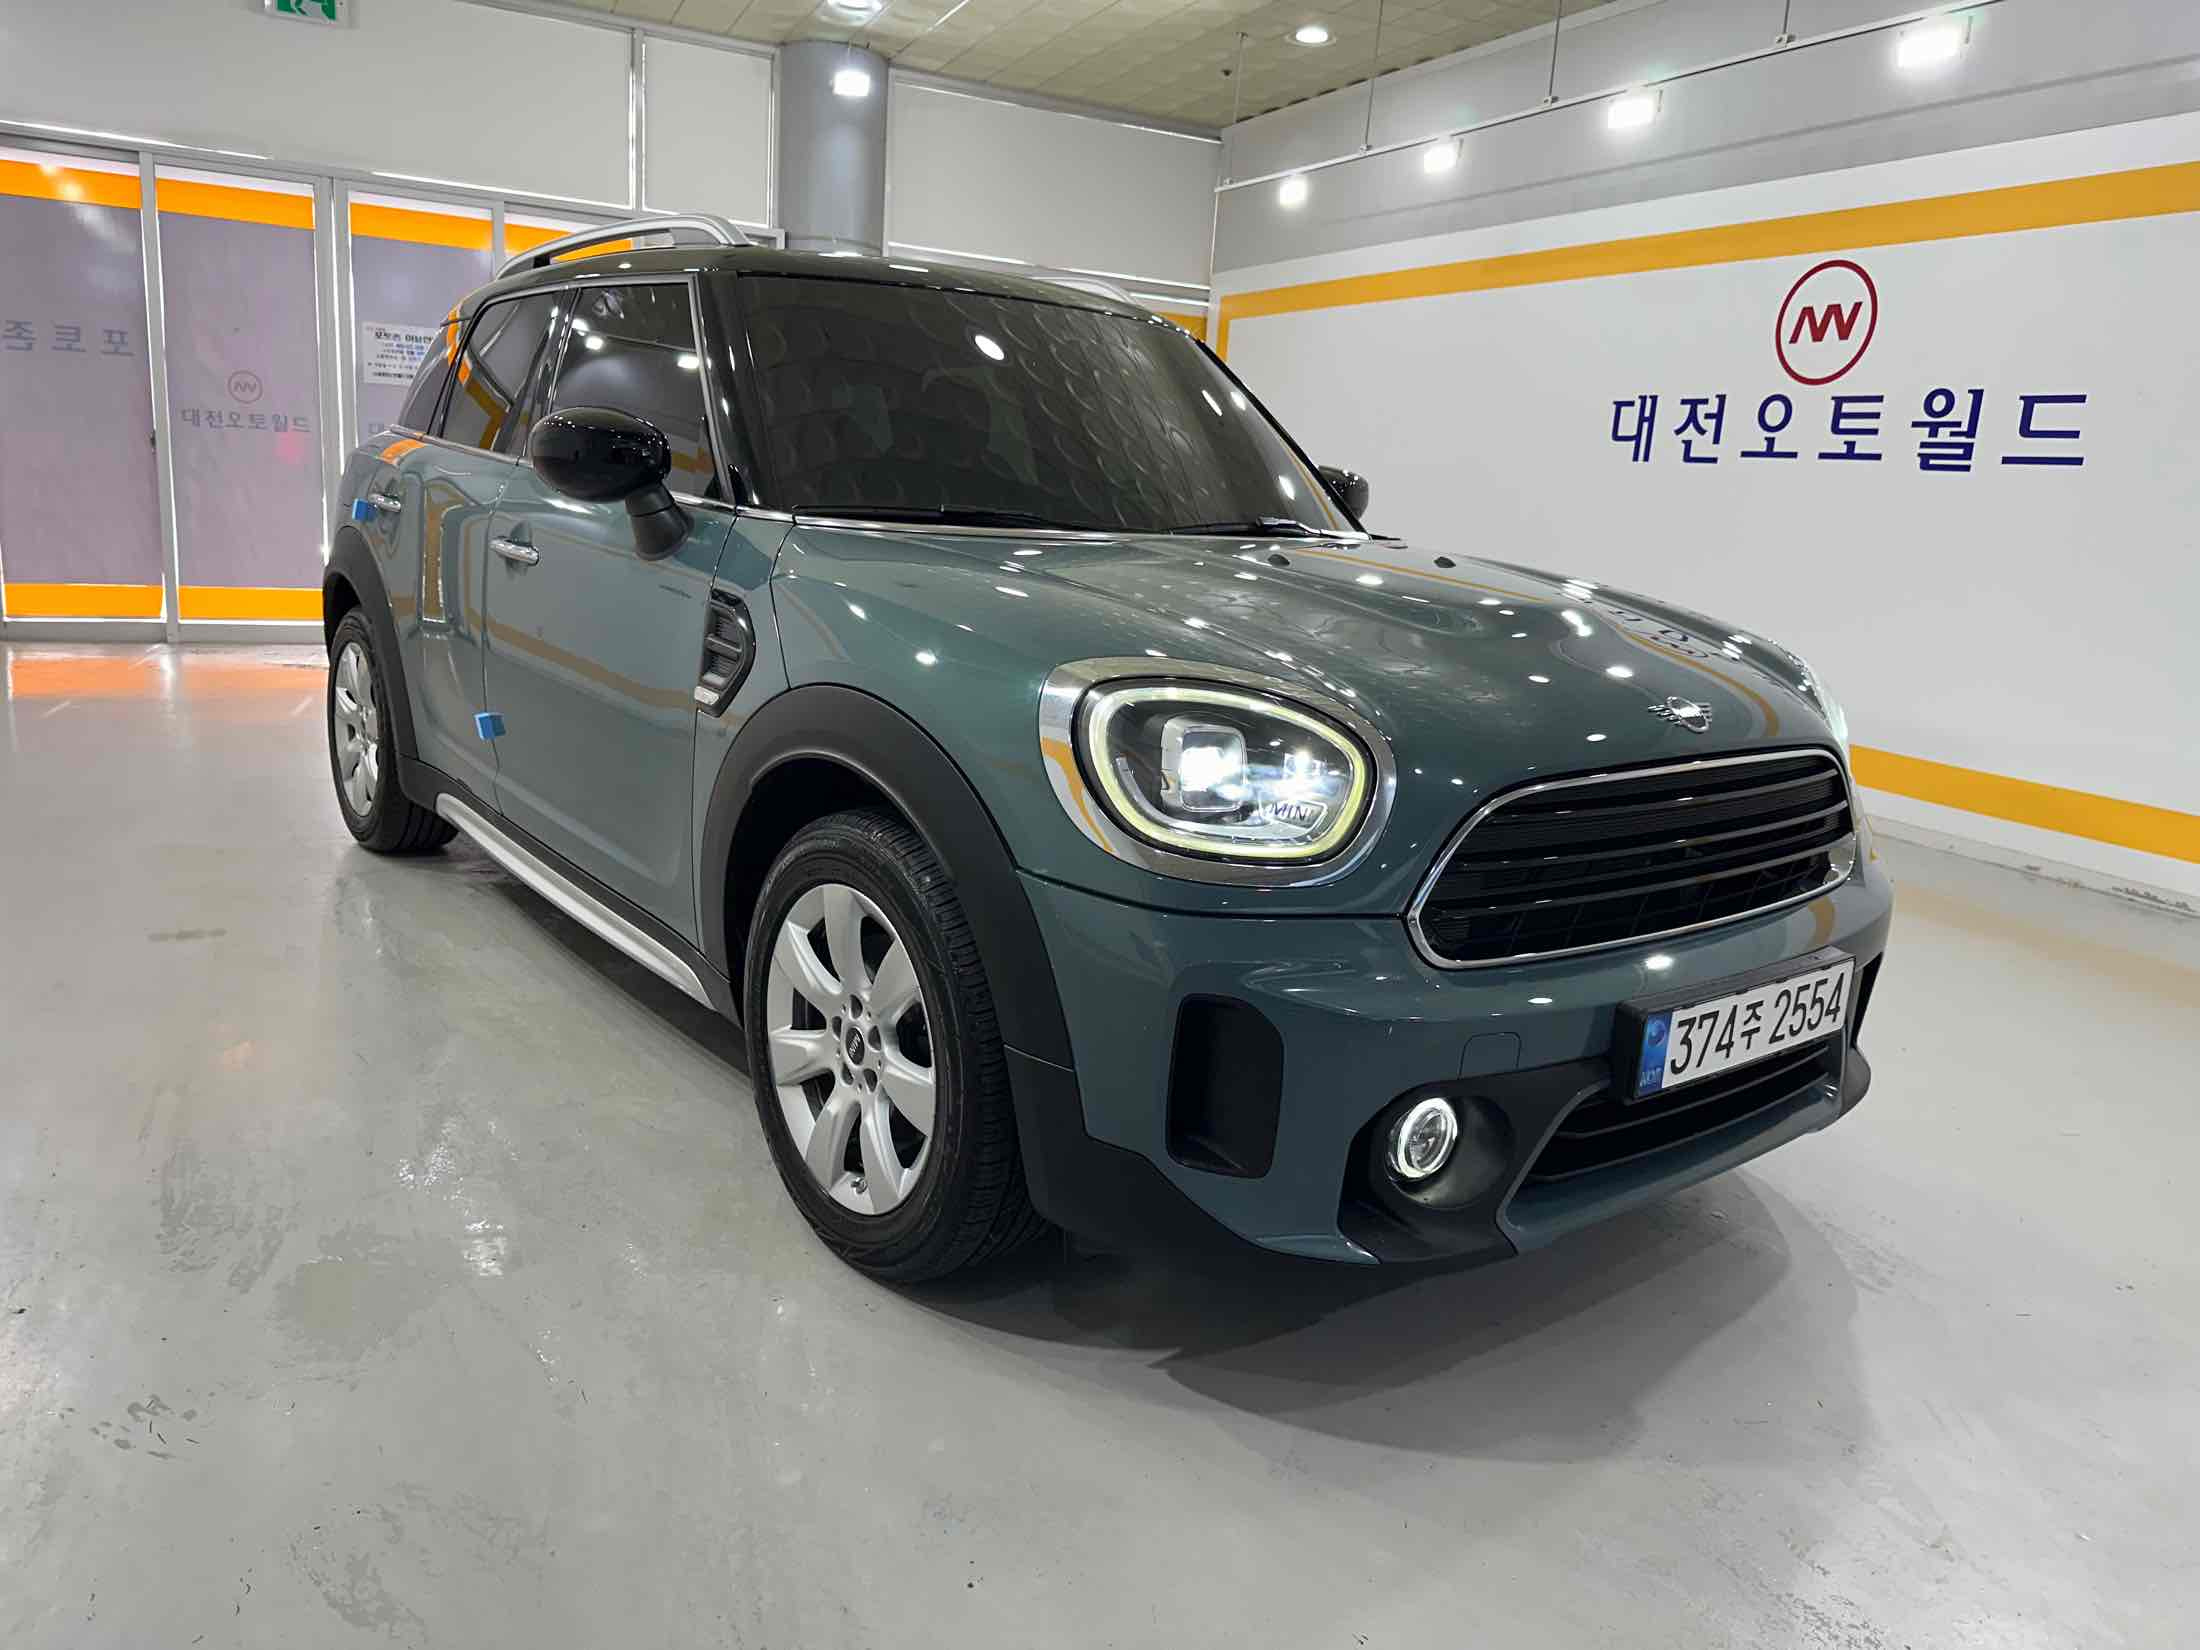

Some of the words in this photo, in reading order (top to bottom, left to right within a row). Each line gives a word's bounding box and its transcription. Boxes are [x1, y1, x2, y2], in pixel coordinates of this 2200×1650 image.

[181, 407, 312, 433] 대전오토월드
[1609, 386, 2089, 473] 대전오토월드
[1670, 1000, 1764, 1075] 374주
[1768, 972, 1845, 1044] 2554
